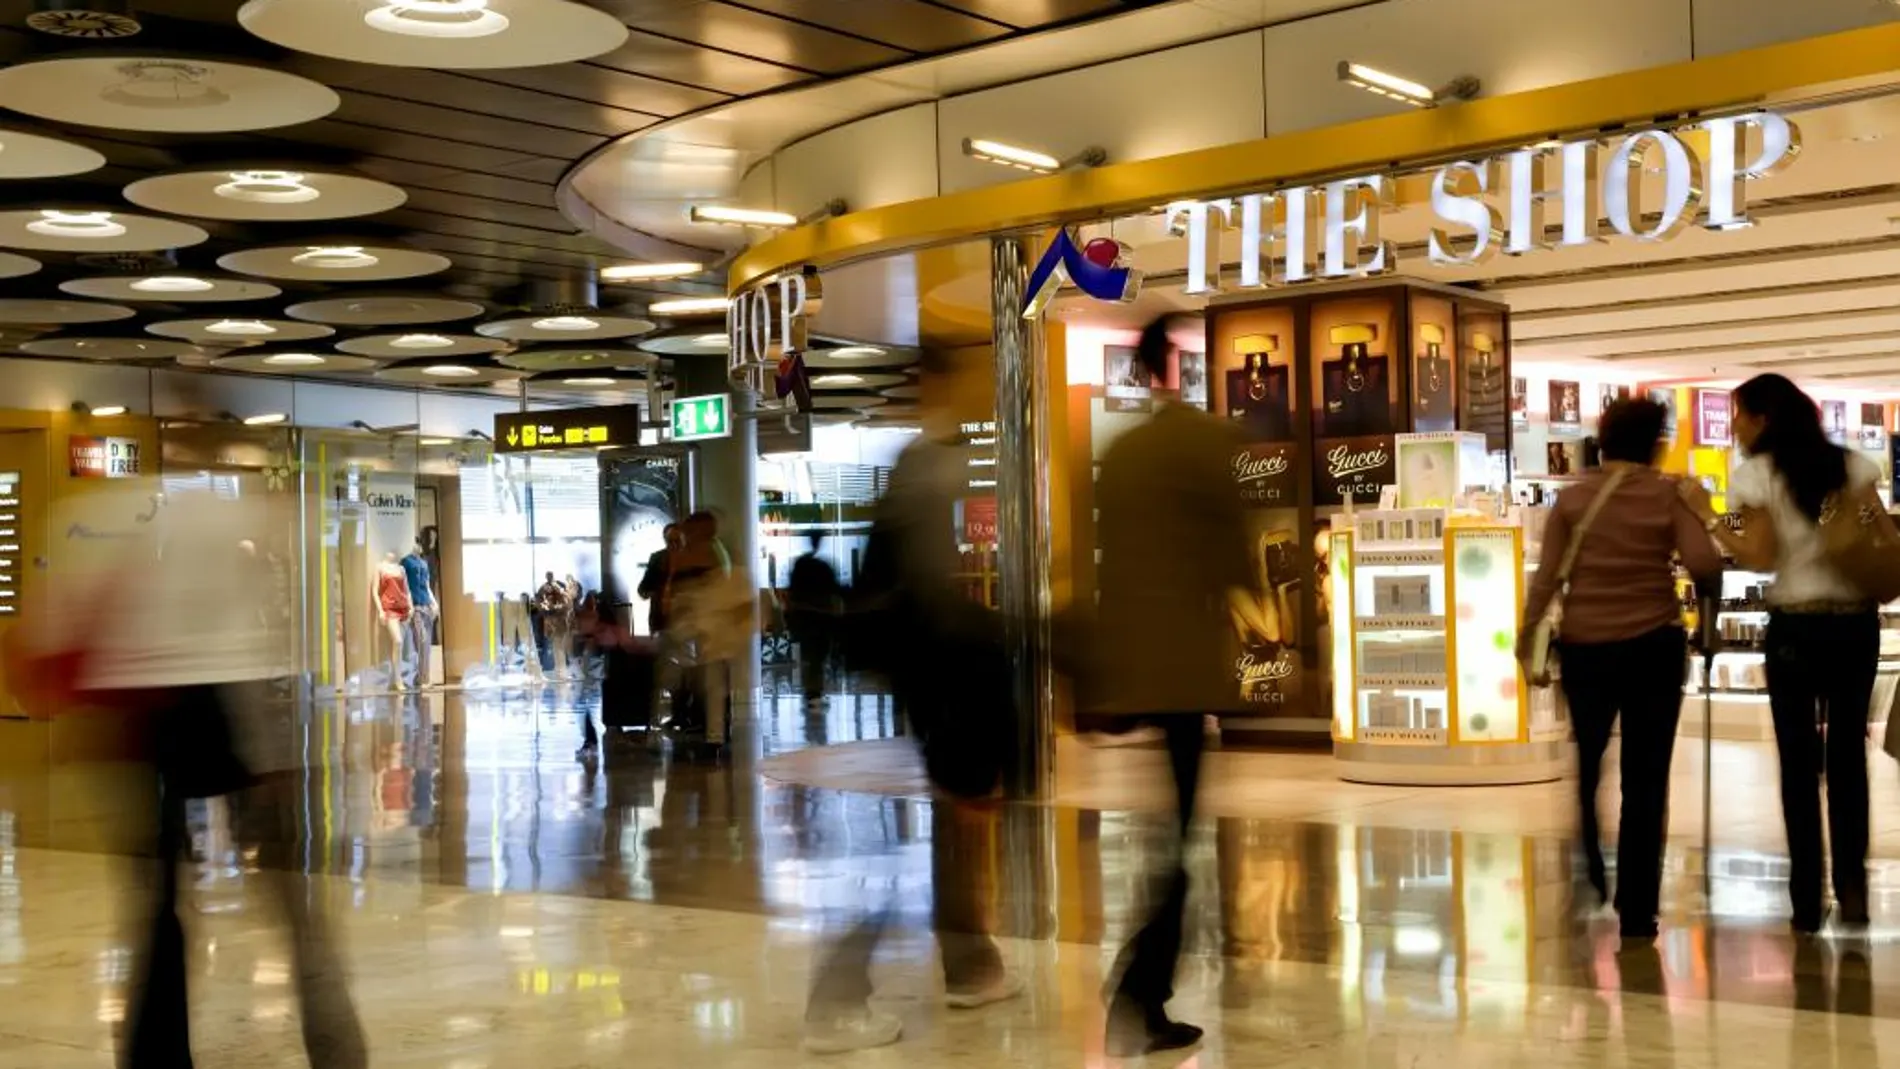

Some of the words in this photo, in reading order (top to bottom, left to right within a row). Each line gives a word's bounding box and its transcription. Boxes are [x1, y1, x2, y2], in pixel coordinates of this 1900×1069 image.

[1166, 174, 1389, 295] THE
[1428, 111, 1800, 265] SHOP
[111, 443, 139, 457] DTY
[1327, 442, 1388, 478] Gucci
[111, 459, 139, 472] FREE
[1234, 449, 1287, 482] Gucci
[367, 493, 393, 508] Calvin
[1337, 483, 1380, 495] GUCCI
[1236, 652, 1293, 684] Gucci
